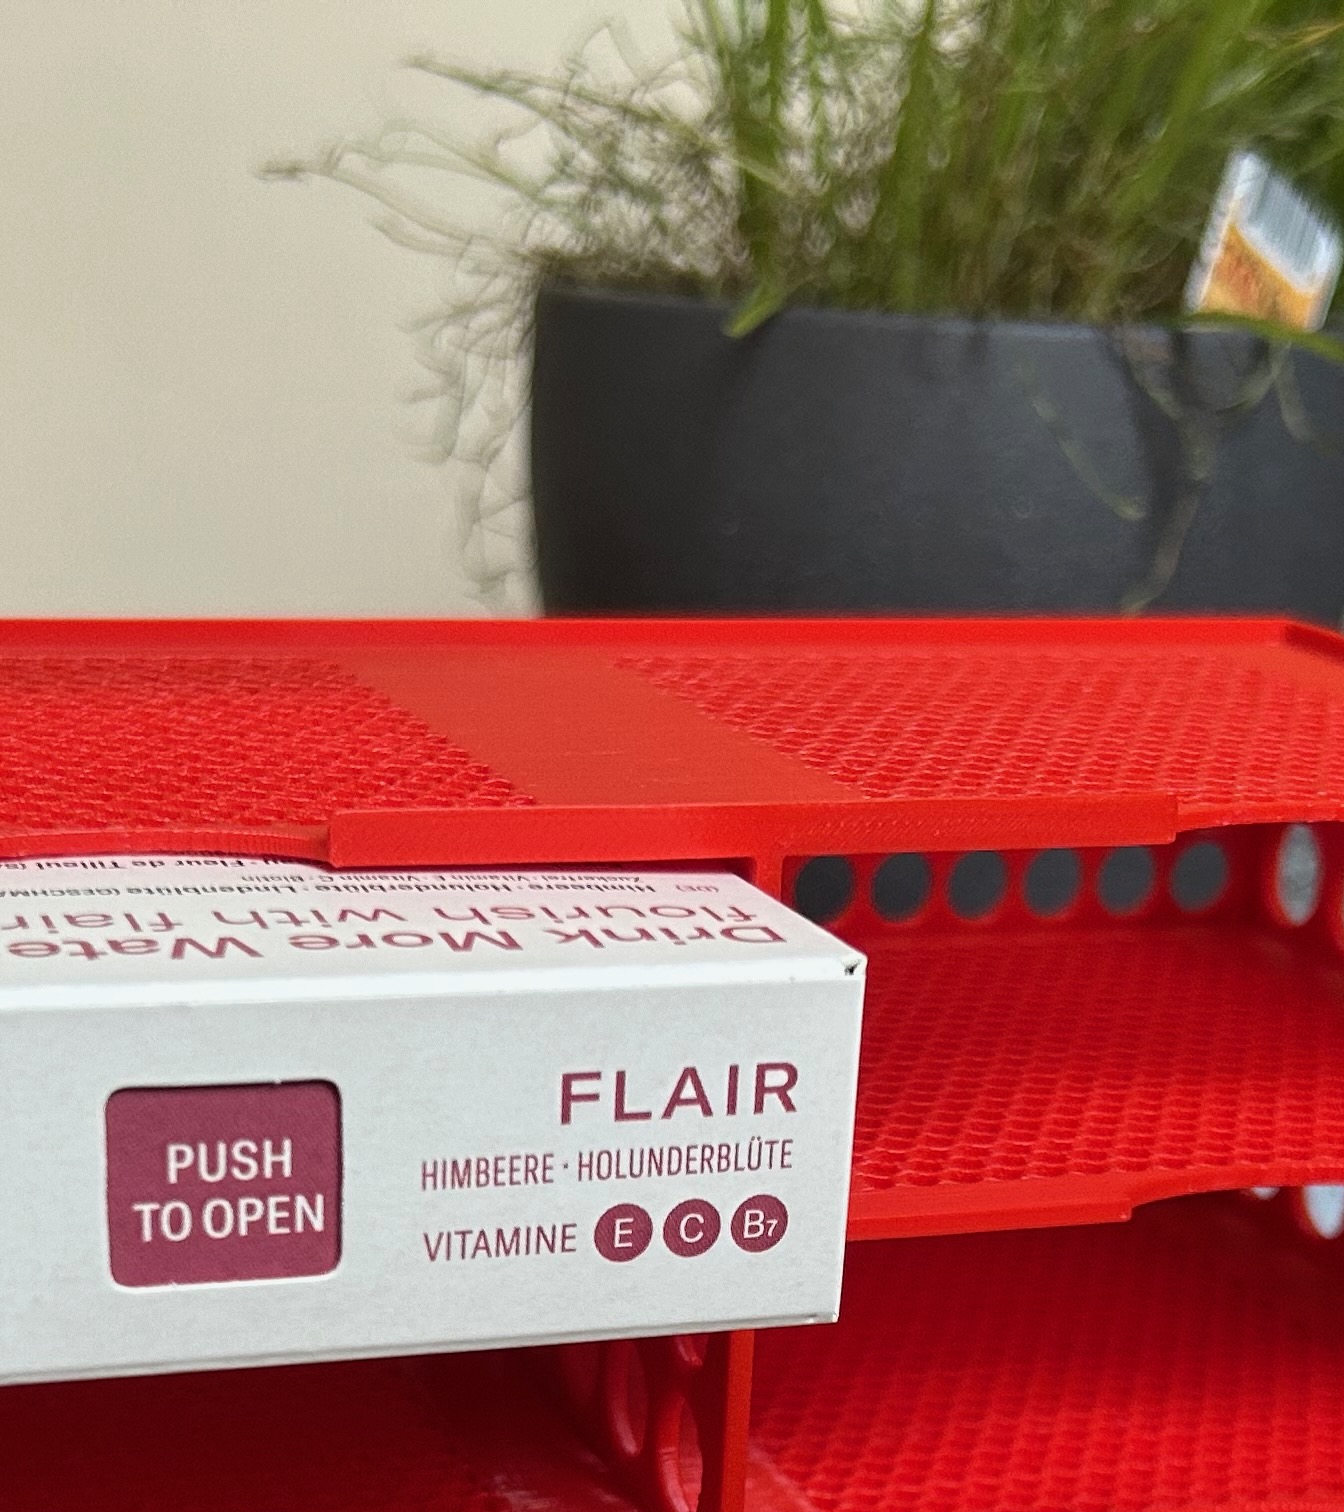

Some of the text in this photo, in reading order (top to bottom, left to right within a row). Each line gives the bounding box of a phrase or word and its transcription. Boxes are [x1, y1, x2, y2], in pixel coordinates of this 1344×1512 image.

[527, 883, 657, 893] Himbeere
[211, 907, 407, 929] with
[432, 904, 758, 924] flourish
[288, 934, 524, 953] More
[543, 927, 787, 948] Drink
[559, 1060, 800, 1126] FLAIR
[167, 1137, 294, 1186] PUSH
[421, 1136, 794, 1192] HIMBEERE HOLUNDERBLÜTE
[132, 1193, 326, 1244] TO OPEN
[423, 1222, 578, 1263] VITAMINE
